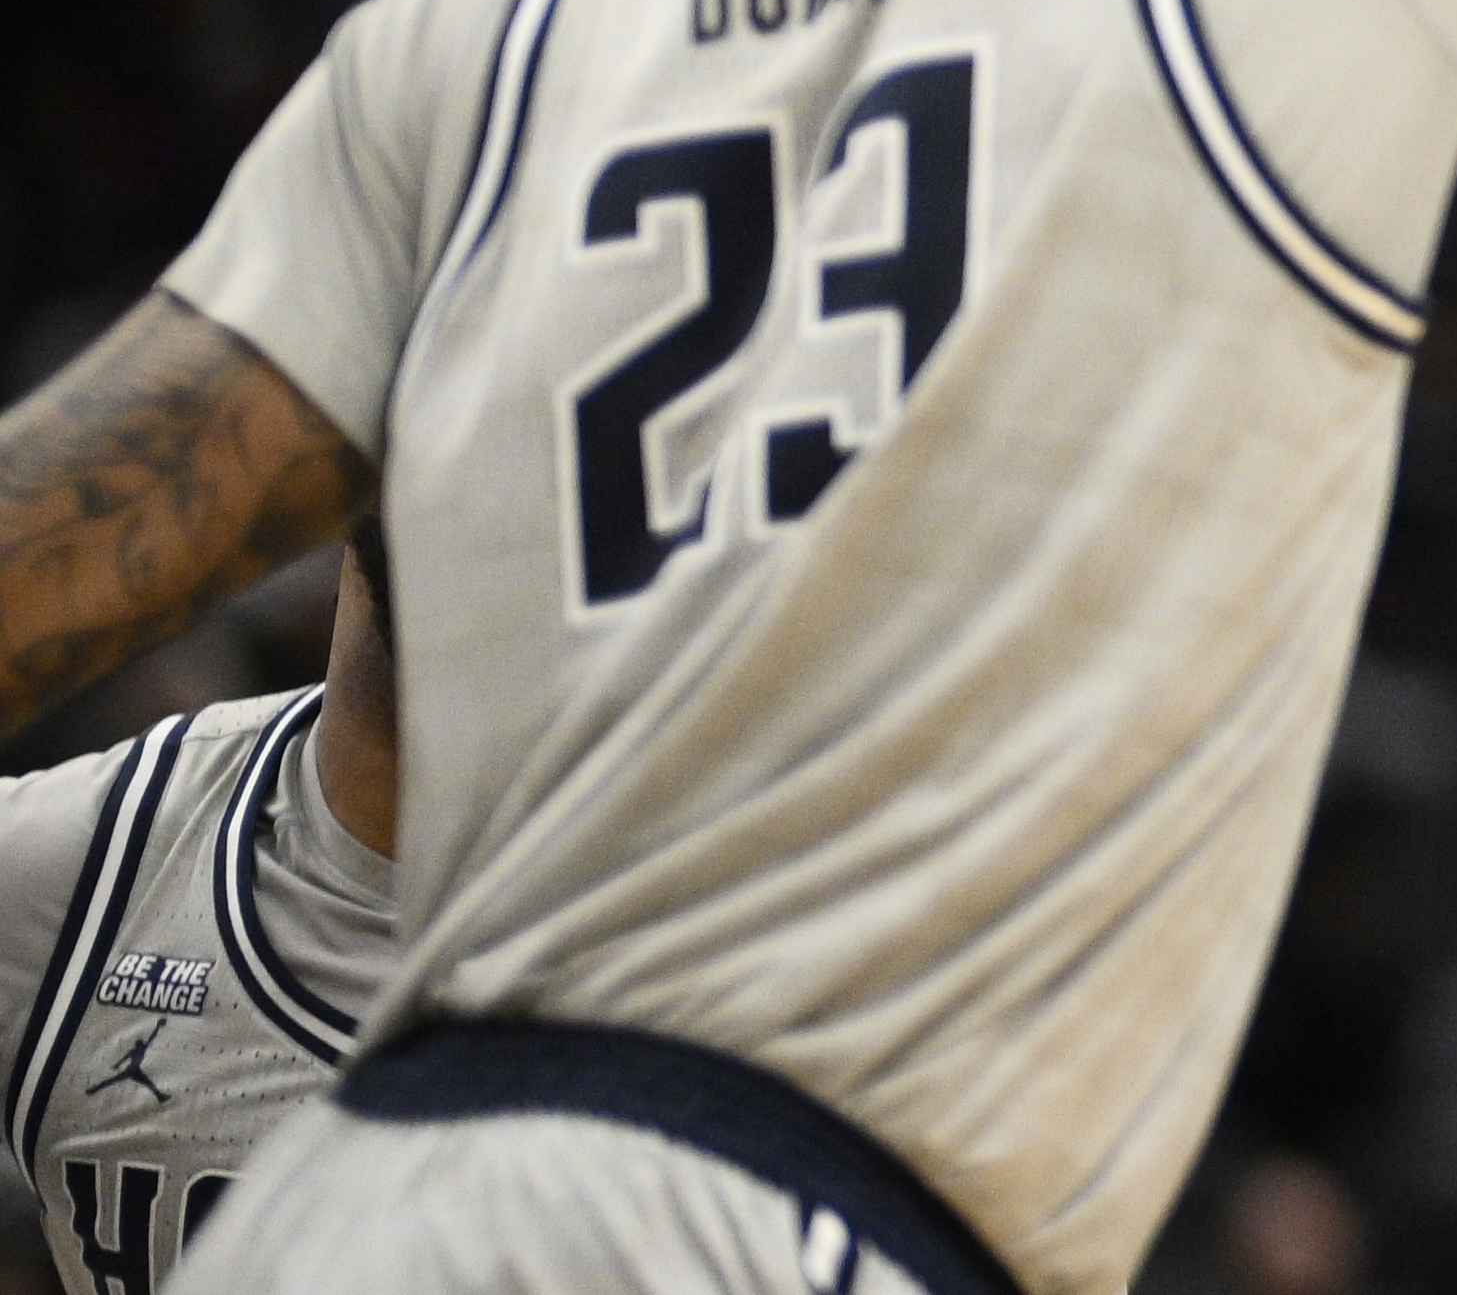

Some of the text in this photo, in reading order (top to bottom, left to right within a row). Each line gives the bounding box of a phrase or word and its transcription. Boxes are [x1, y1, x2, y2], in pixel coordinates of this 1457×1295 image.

[565, 42, 988, 615] 23
[115, 954, 211, 985] BE THE
[98, 976, 207, 1014] CHANGE
